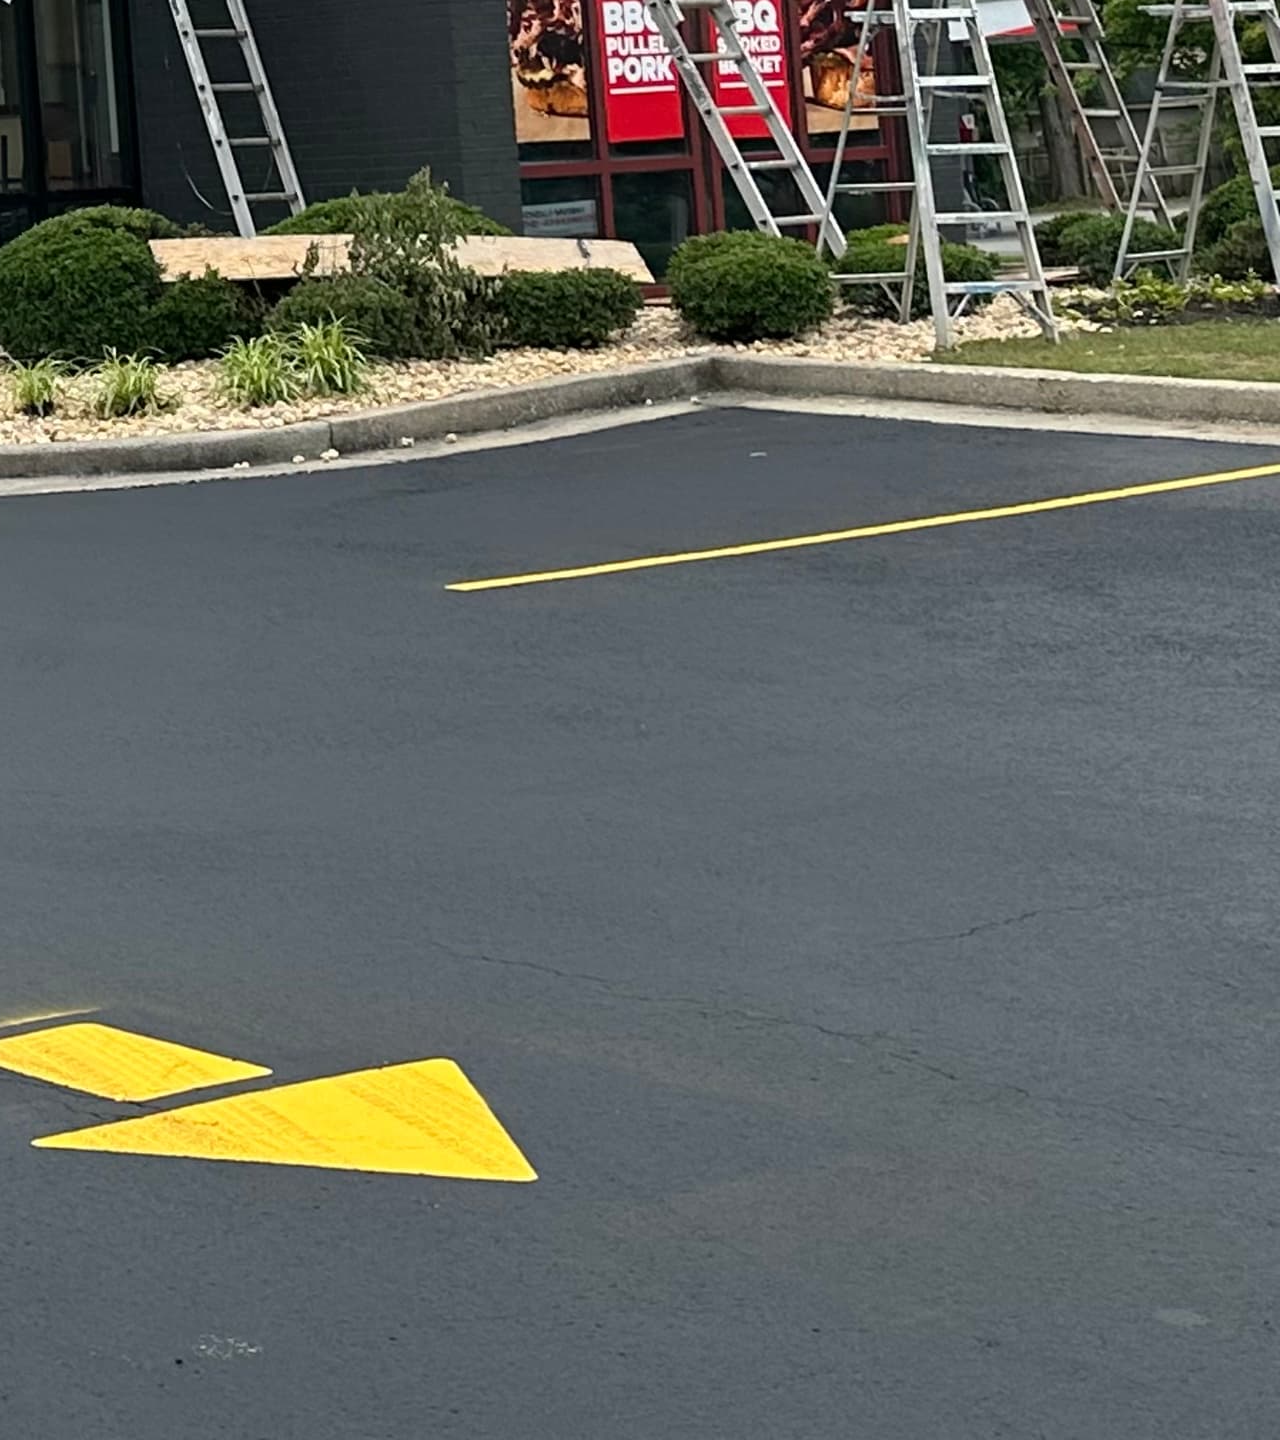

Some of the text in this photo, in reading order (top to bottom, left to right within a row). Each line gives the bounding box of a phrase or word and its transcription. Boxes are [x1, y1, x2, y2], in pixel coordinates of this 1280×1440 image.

[716, 0, 780, 33] BQ
[716, 35, 781, 54] SOKED
[608, 55, 675, 84] PORK
[718, 55, 782, 76] BRKET
